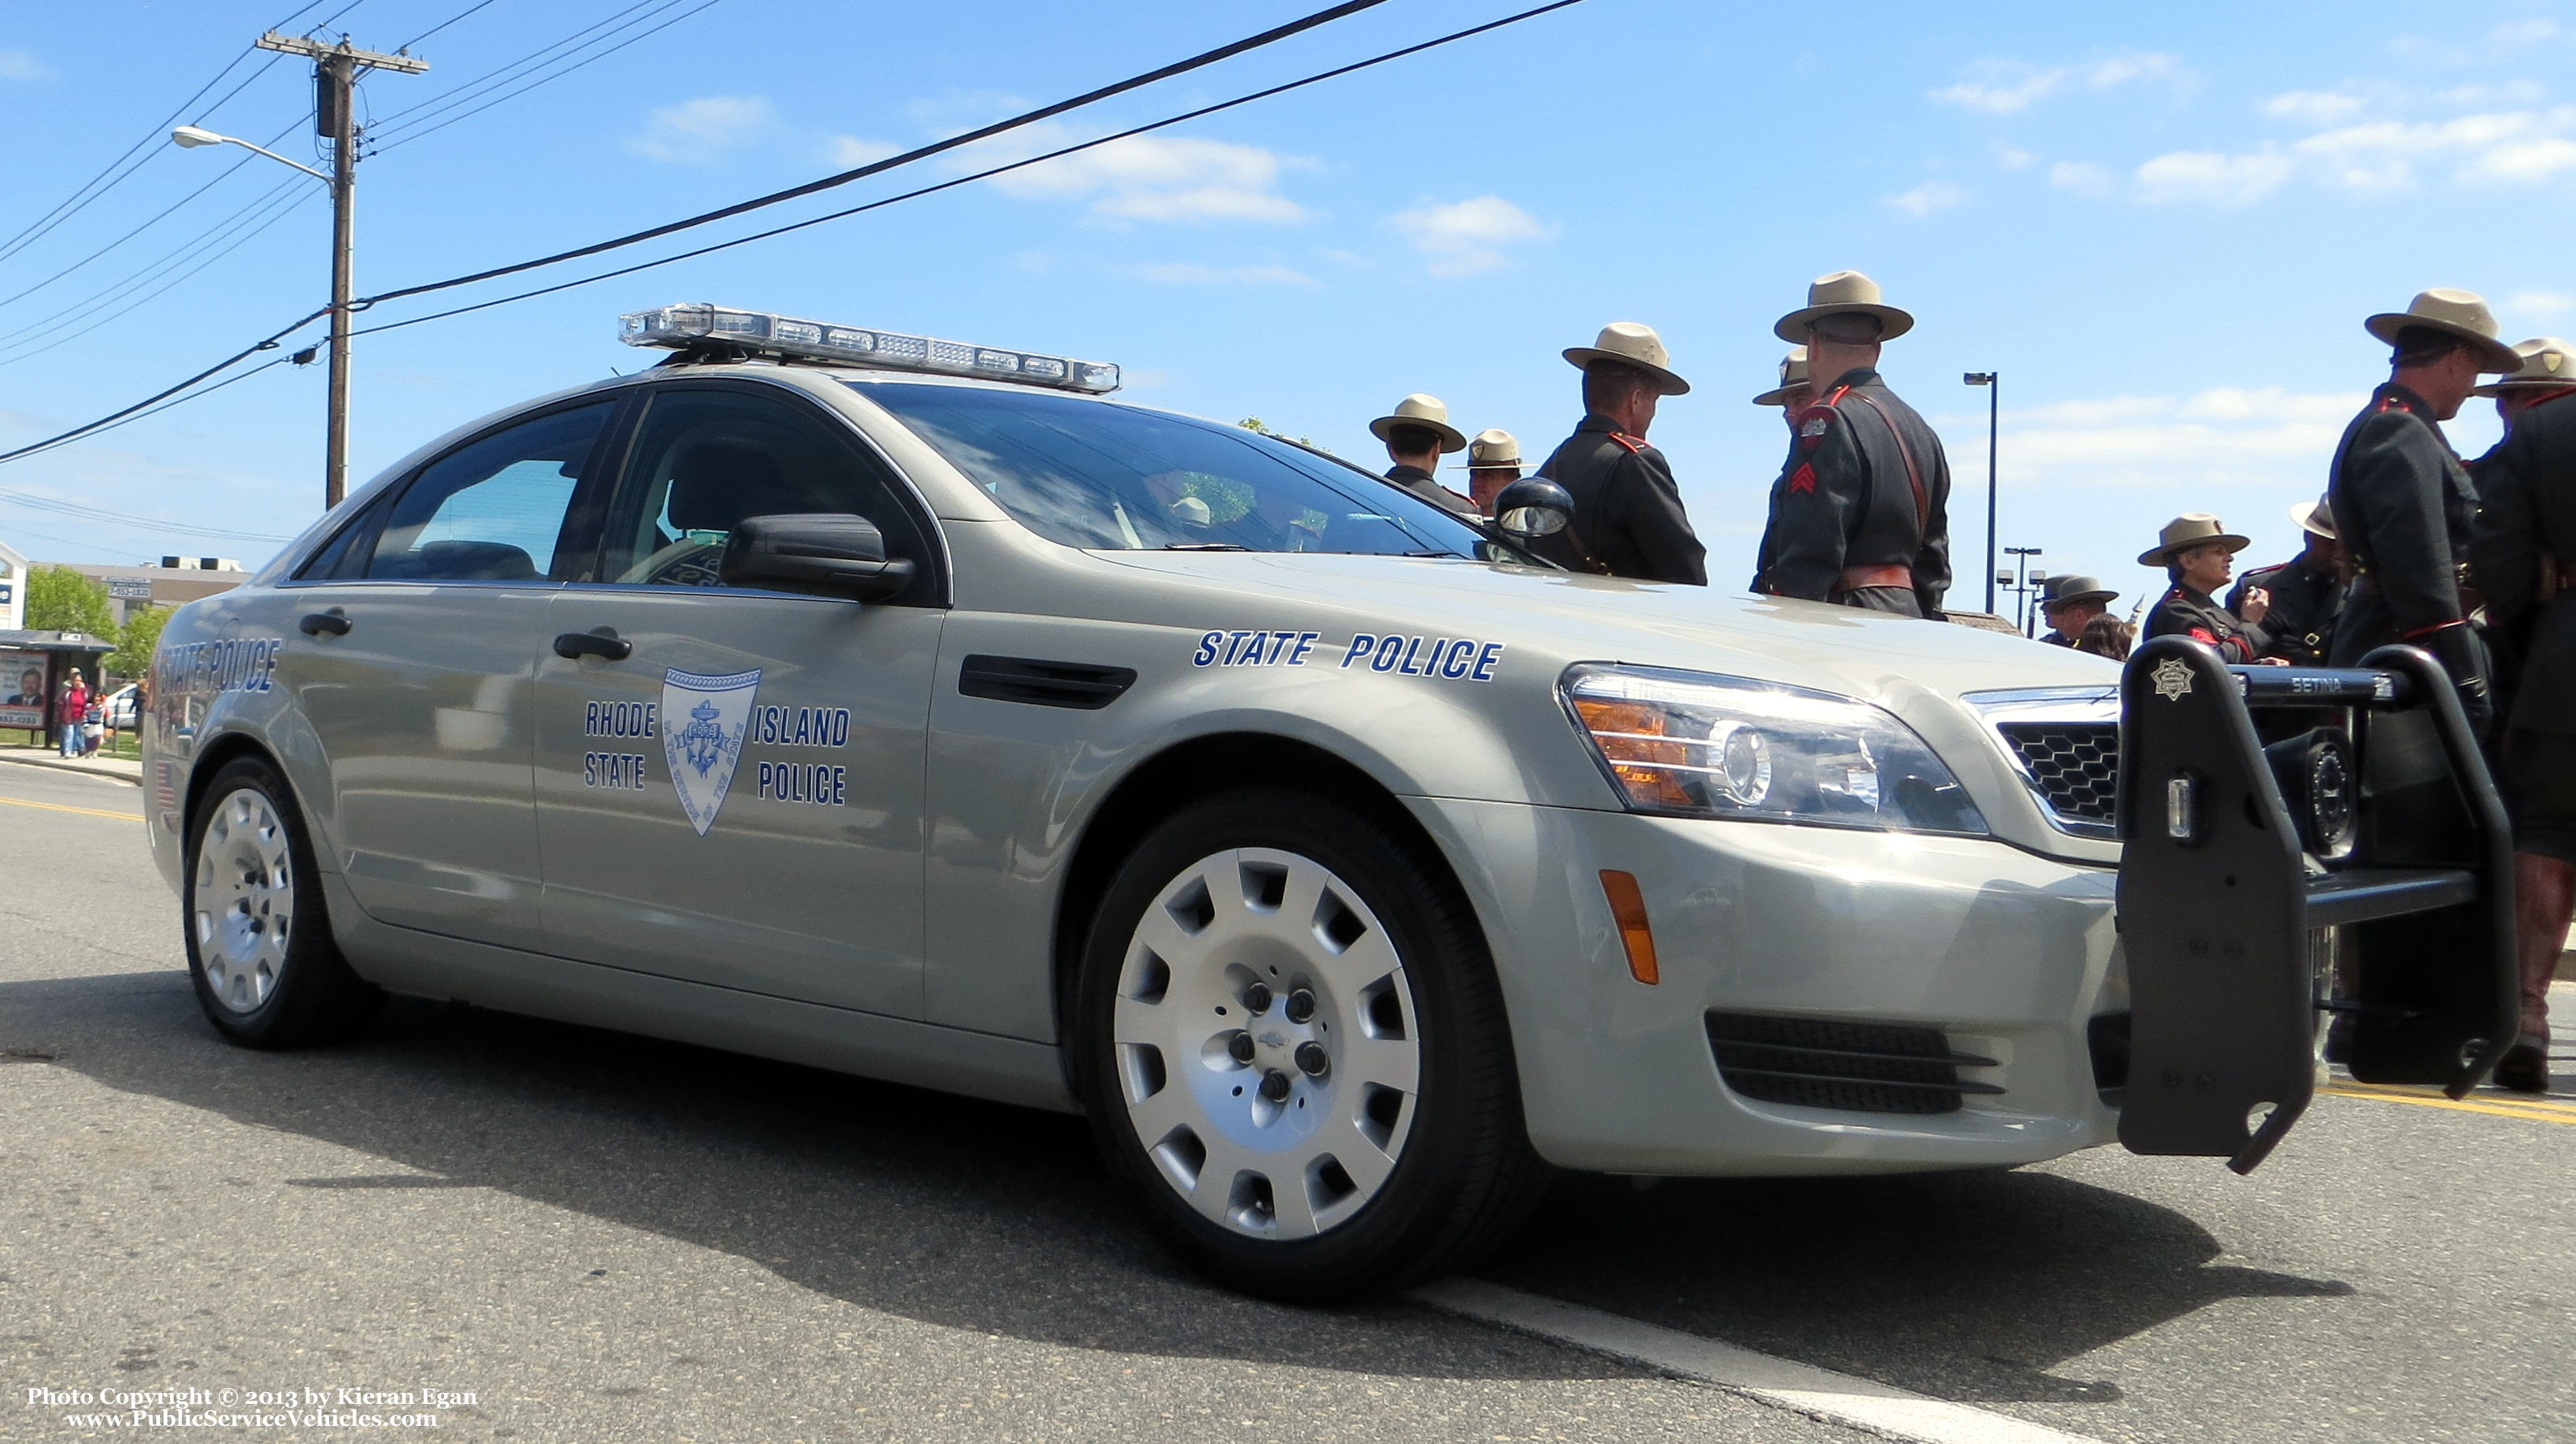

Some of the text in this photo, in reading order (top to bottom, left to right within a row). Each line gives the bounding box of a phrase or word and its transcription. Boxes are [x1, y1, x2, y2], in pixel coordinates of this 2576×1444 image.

[160, 637, 282, 695] STATE POLICE
[1192, 630, 1507, 682] STATE POLICE
[2292, 677, 2341, 694] SETINA
[585, 701, 657, 738] RHODE
[753, 705, 851, 748] ISLAND
[584, 752, 645, 790] STATE
[758, 761, 846, 806] POLICE
